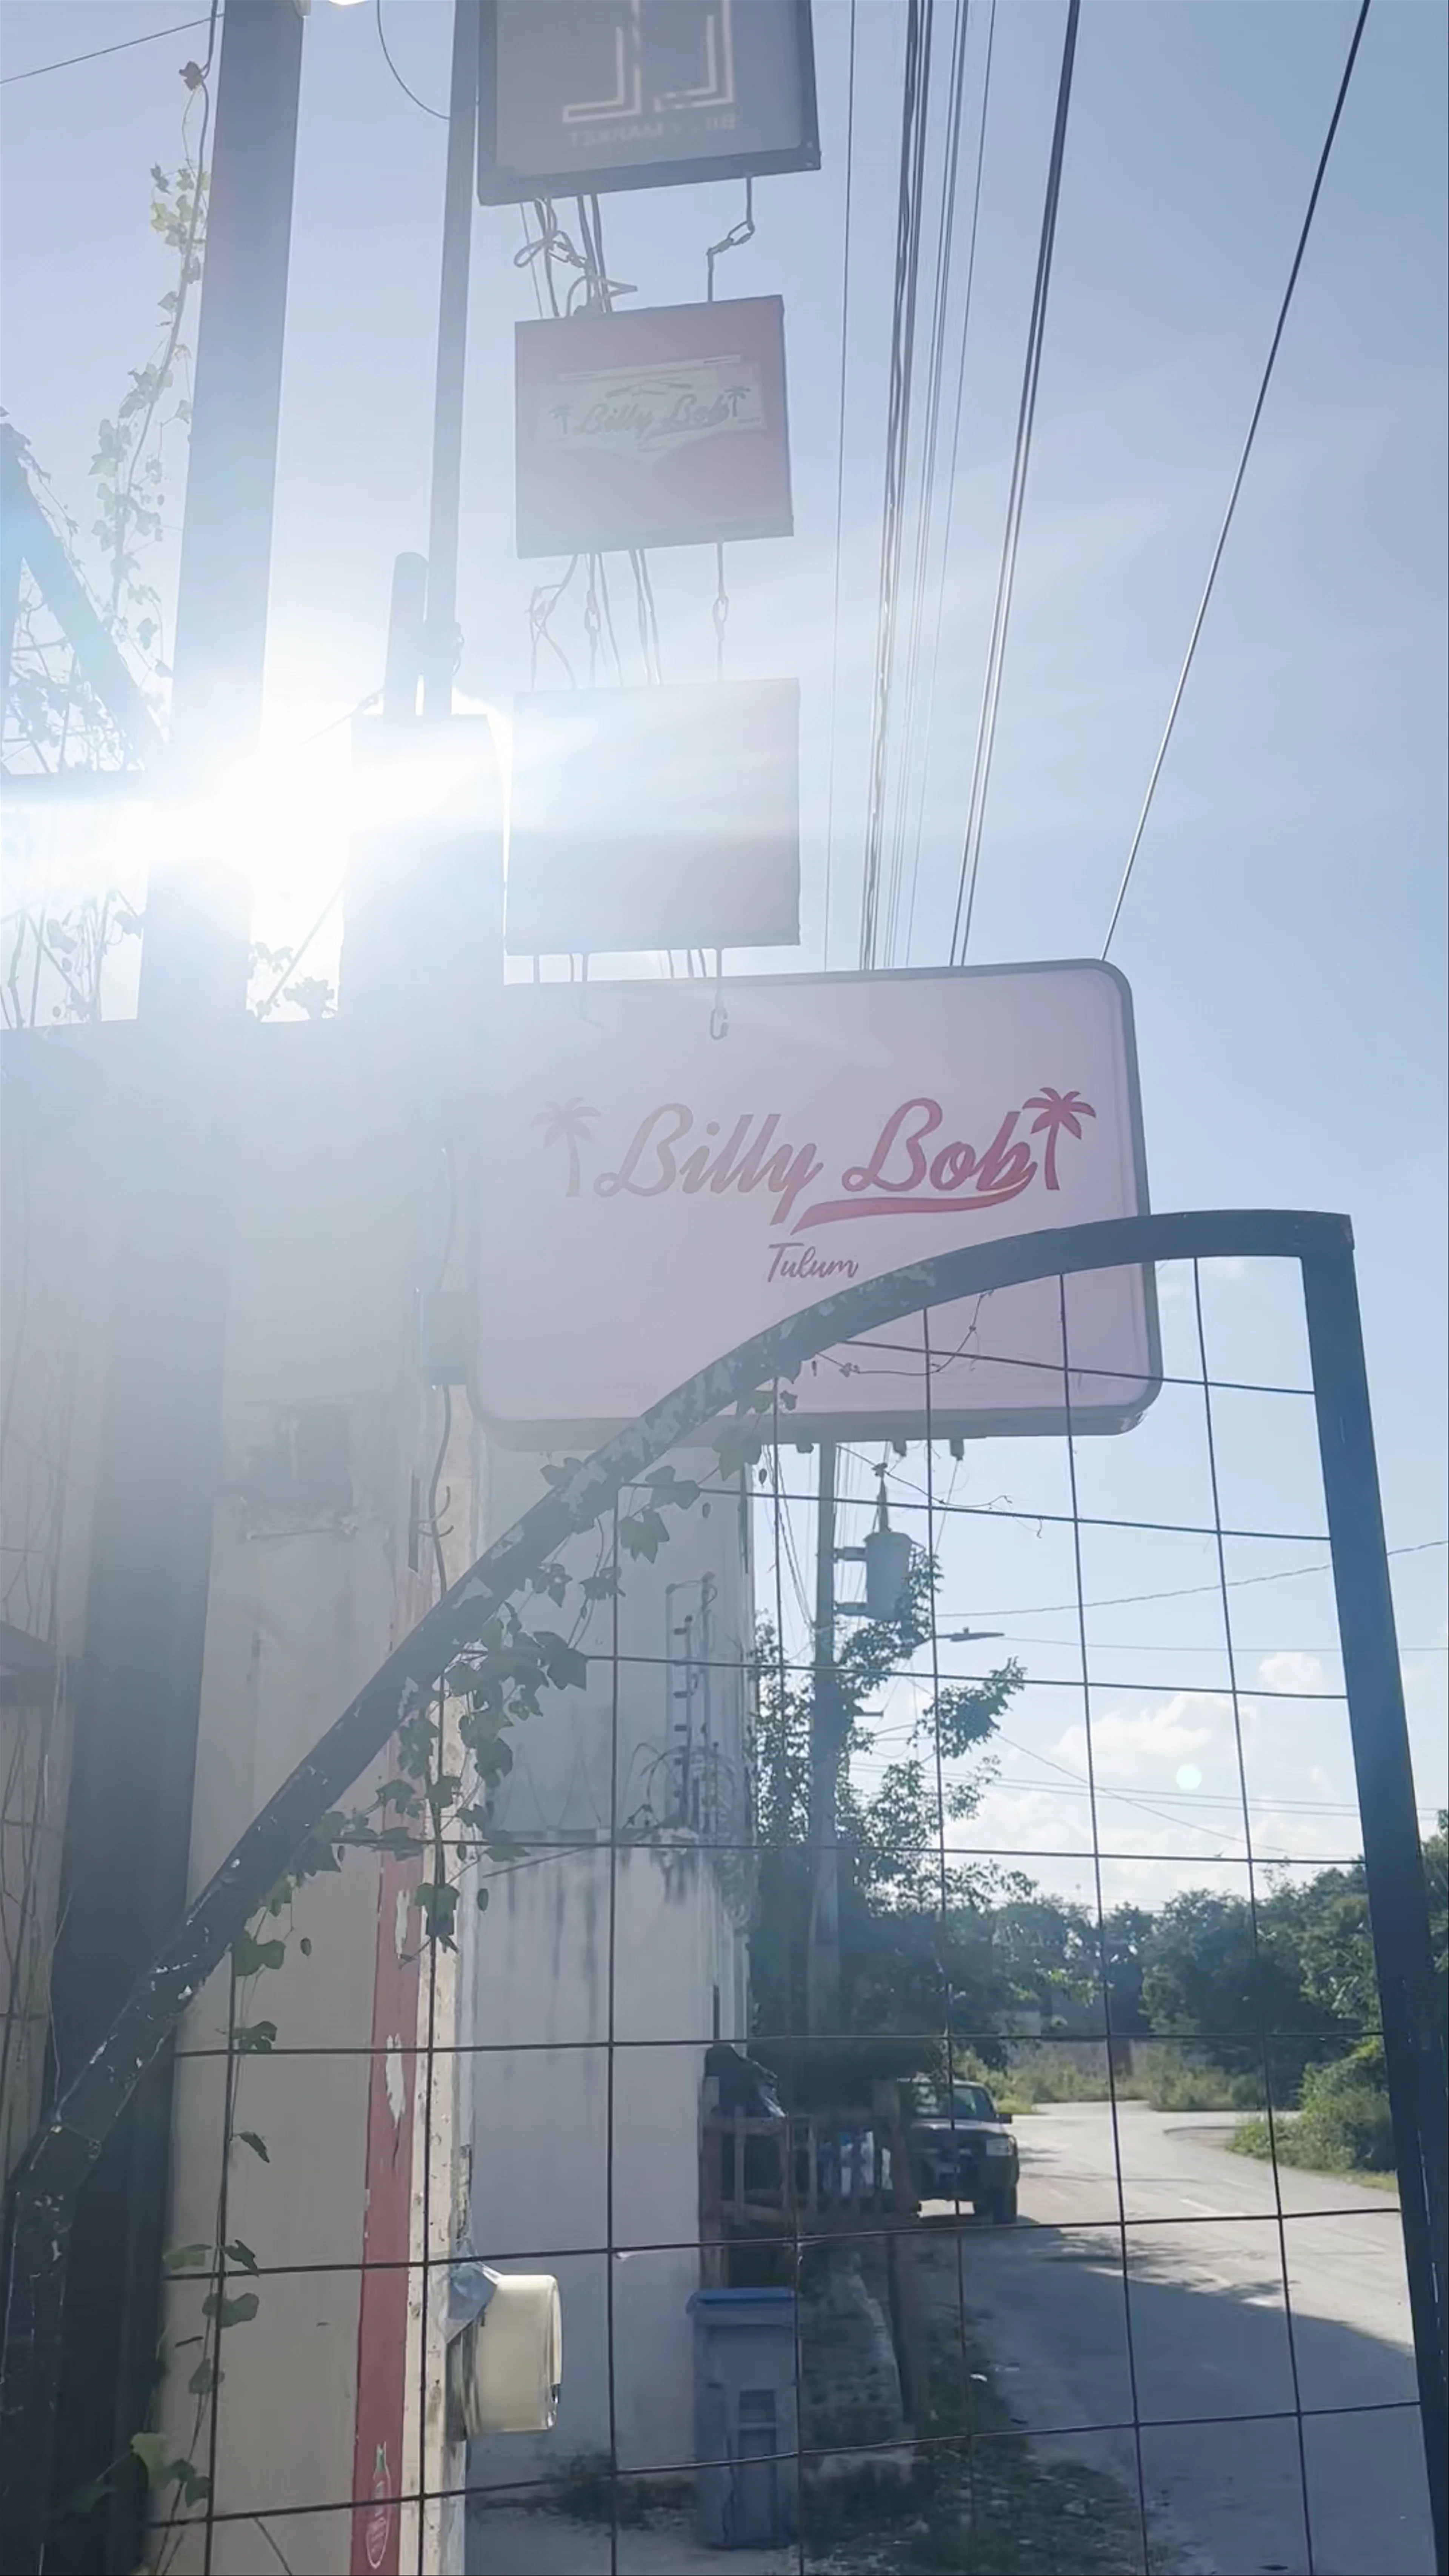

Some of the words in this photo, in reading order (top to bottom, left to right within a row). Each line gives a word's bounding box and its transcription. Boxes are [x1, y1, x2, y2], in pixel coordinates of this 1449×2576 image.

[572, 403, 654, 439] Billy
[657, 394, 730, 427] Bob
[592, 1102, 824, 1226] Billy
[841, 1097, 1038, 1192] Bob
[768, 1242, 859, 1283] Tulum
